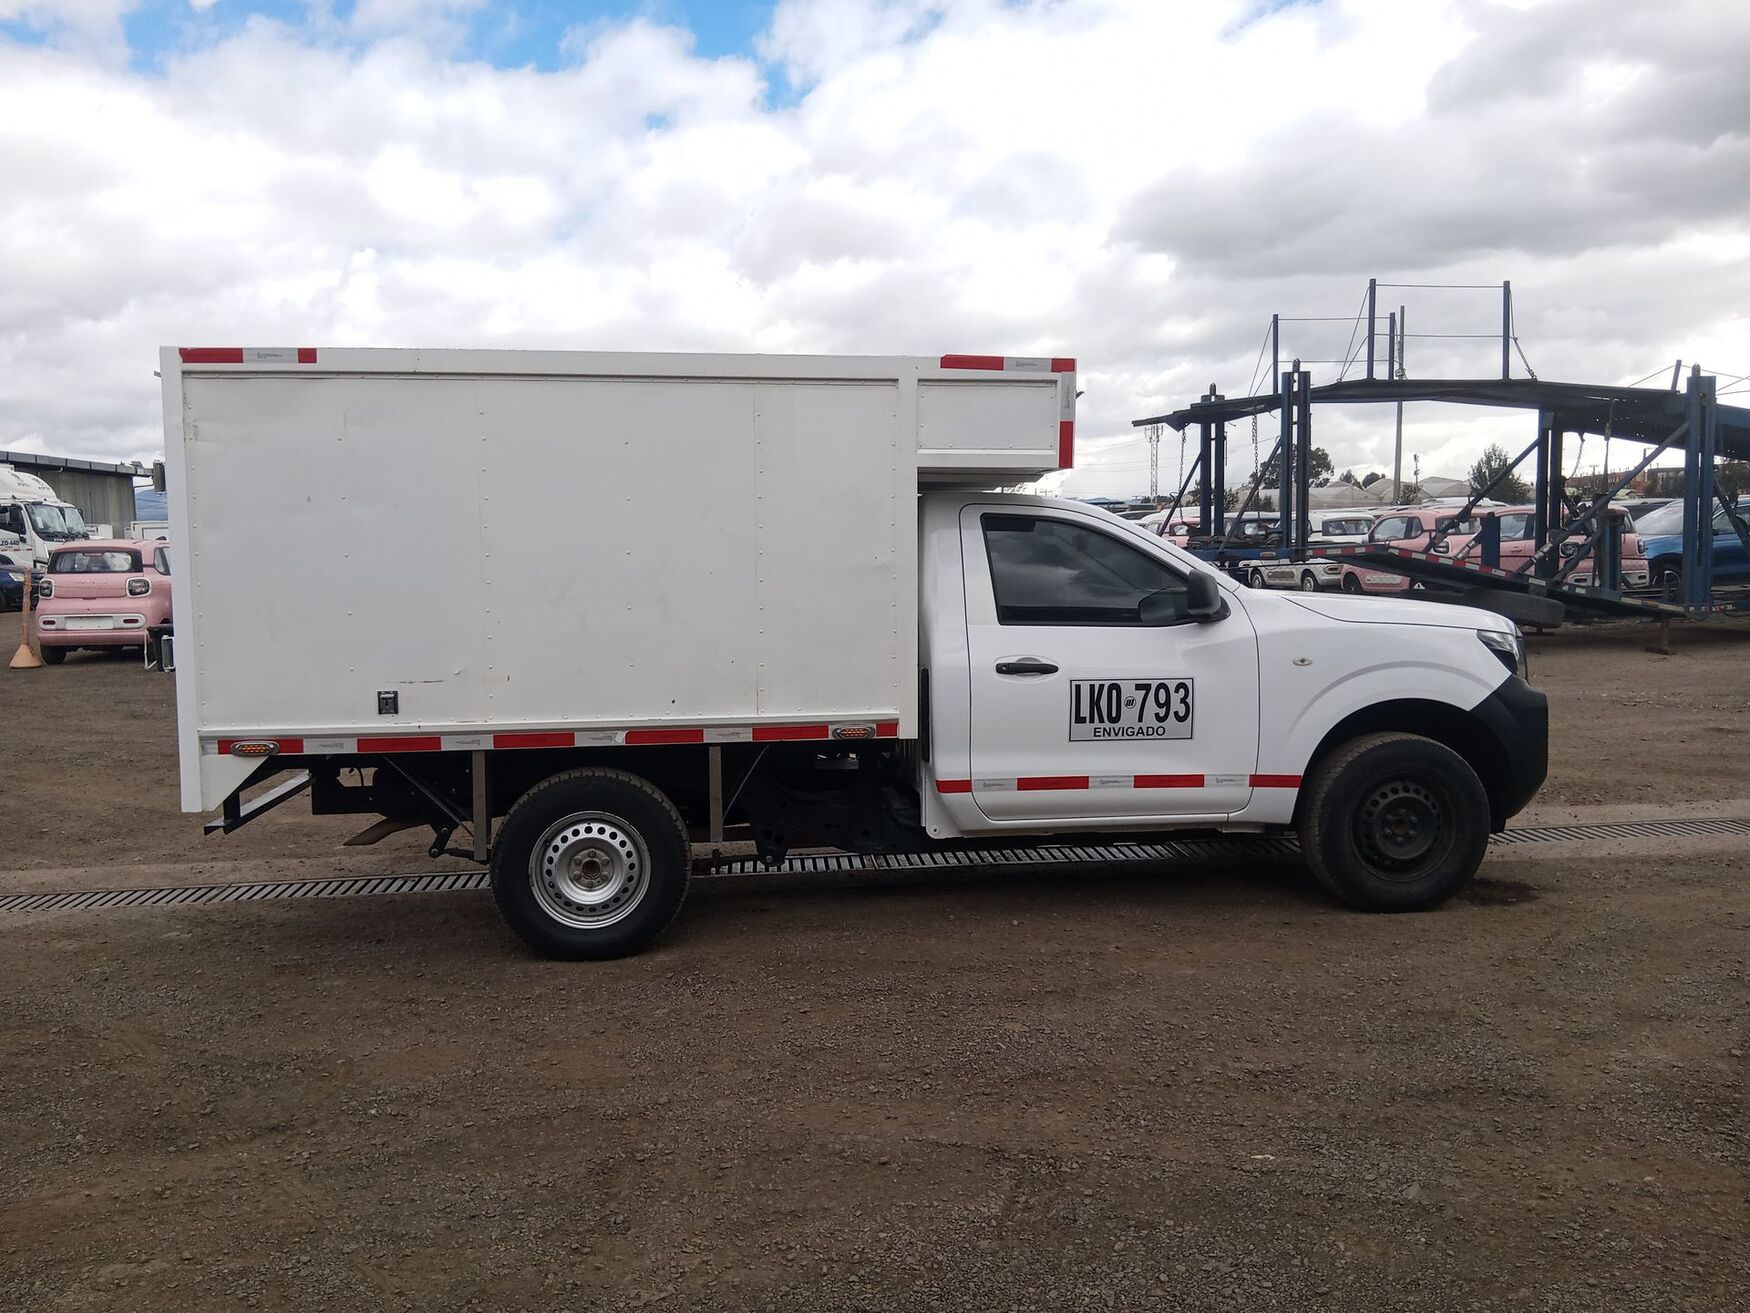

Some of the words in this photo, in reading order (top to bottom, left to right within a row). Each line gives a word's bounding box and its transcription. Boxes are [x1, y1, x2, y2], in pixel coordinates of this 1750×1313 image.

[1074, 682, 1122, 724] LKO
[1135, 682, 1191, 723] 793
[1093, 726, 1166, 738] ENVIGADO
